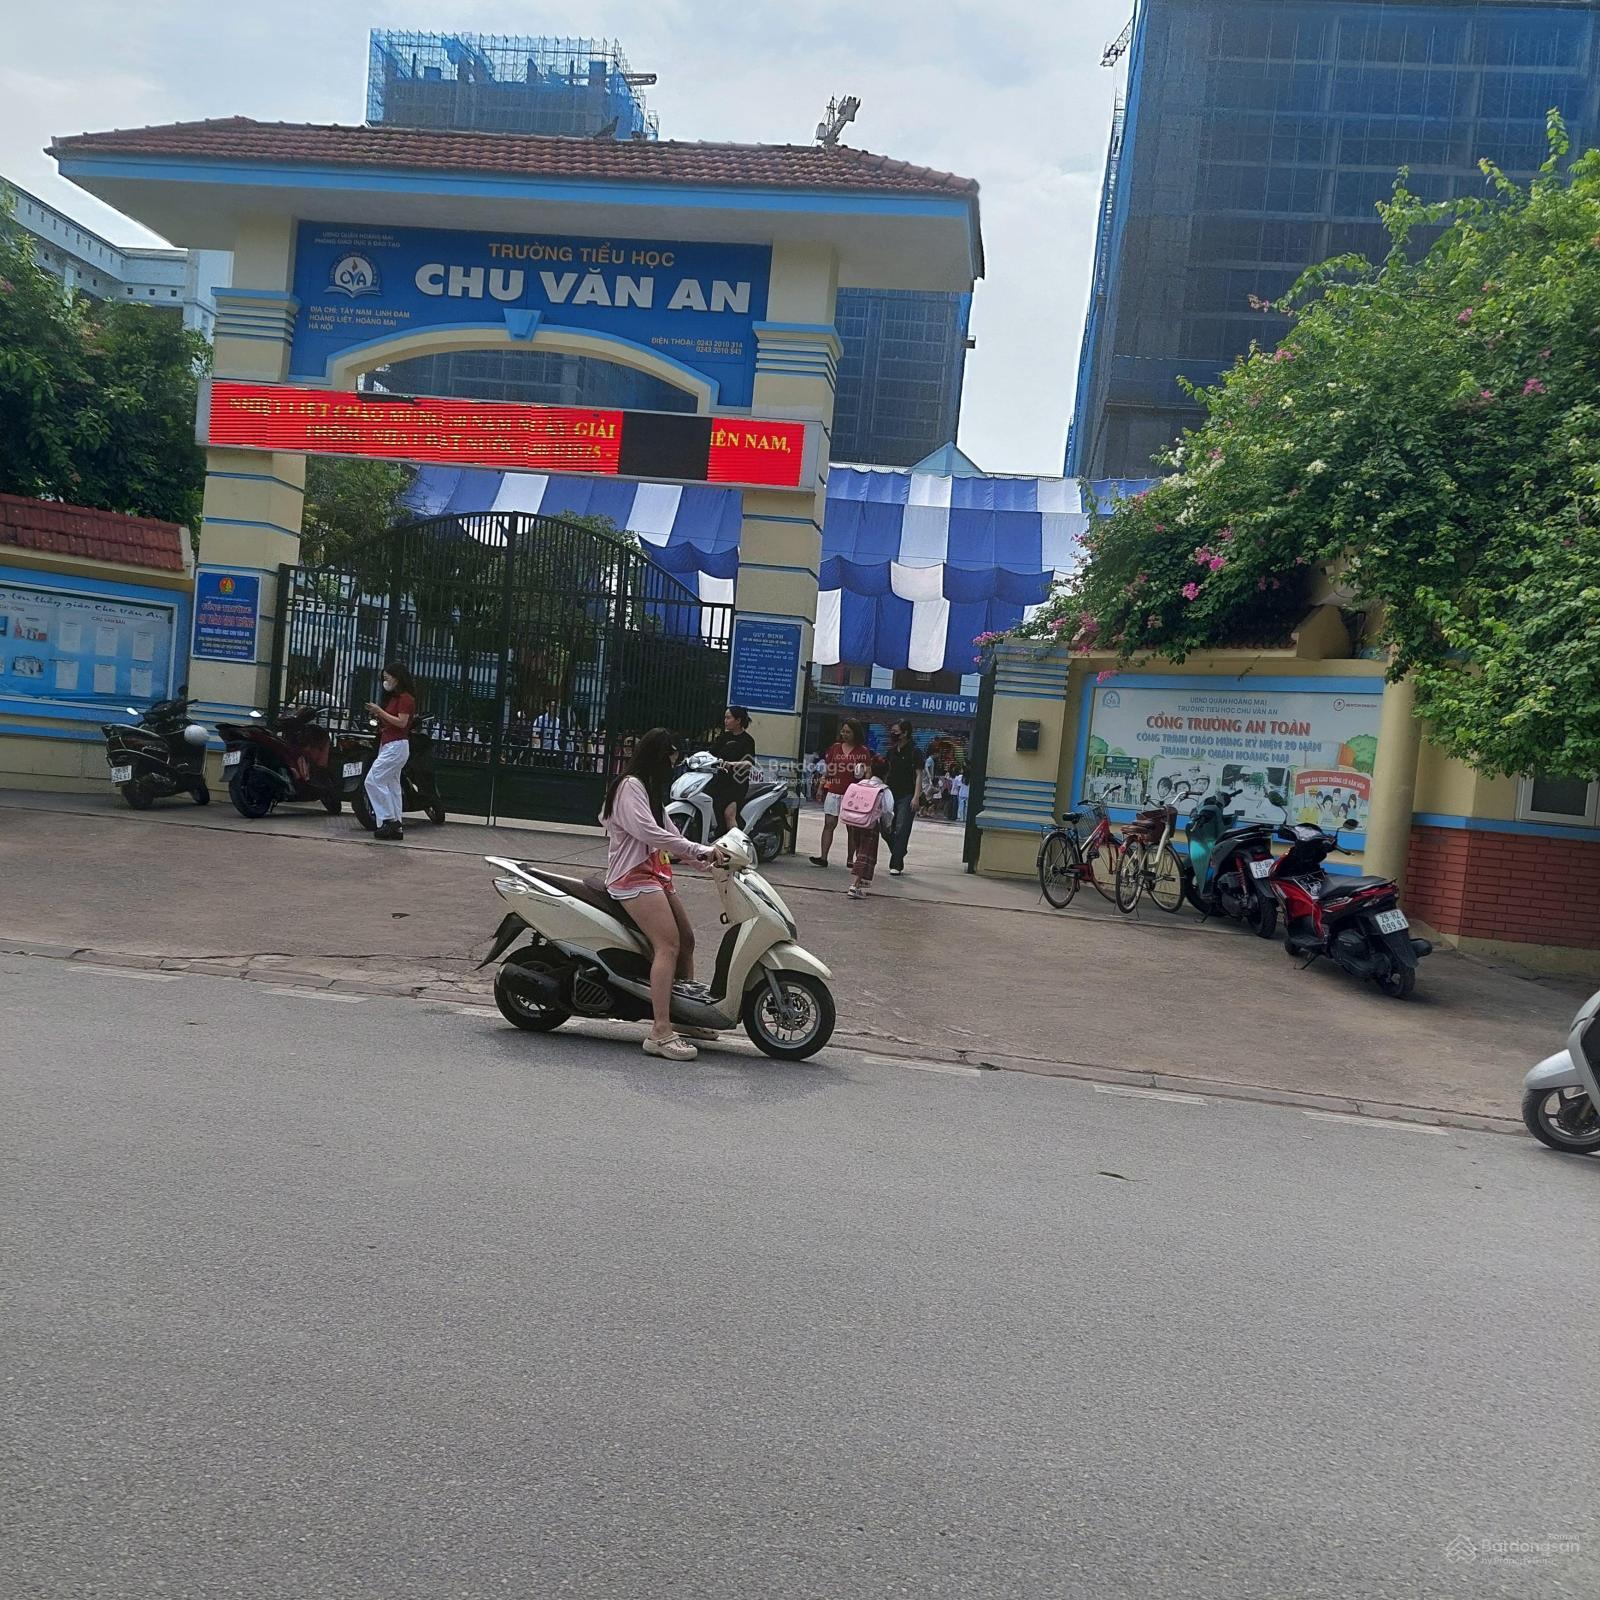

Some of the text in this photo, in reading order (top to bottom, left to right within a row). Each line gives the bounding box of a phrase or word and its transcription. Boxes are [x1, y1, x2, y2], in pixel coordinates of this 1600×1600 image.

[488, 241, 675, 267] TRƯỜNG TIỂU HỌC
[414, 263, 525, 301] CHU
[538, 268, 655, 309] VĂN
[666, 278, 751, 313] AN
[309, 313, 335, 322] HOÀNG
[355, 315, 382, 325] HOÀNG
[383, 318, 397, 327] MAI
[375, 309, 392, 317] LINH
[308, 322, 334, 332] HÀ NỘI
[574, 418, 616, 440] GIẢI
[744, 432, 791, 454] NAM,
[851, 690, 874, 704] TIÊN
[876, 694, 897, 708] HỌC
[899, 692, 912, 707] LỄ
[922, 697, 943, 712] HẬU
[945, 700, 966, 714] HỌC
[1236, 707, 1252, 715] CHU
[1146, 710, 1311, 737] CỔNG TRƯỜNG AN TOÀN
